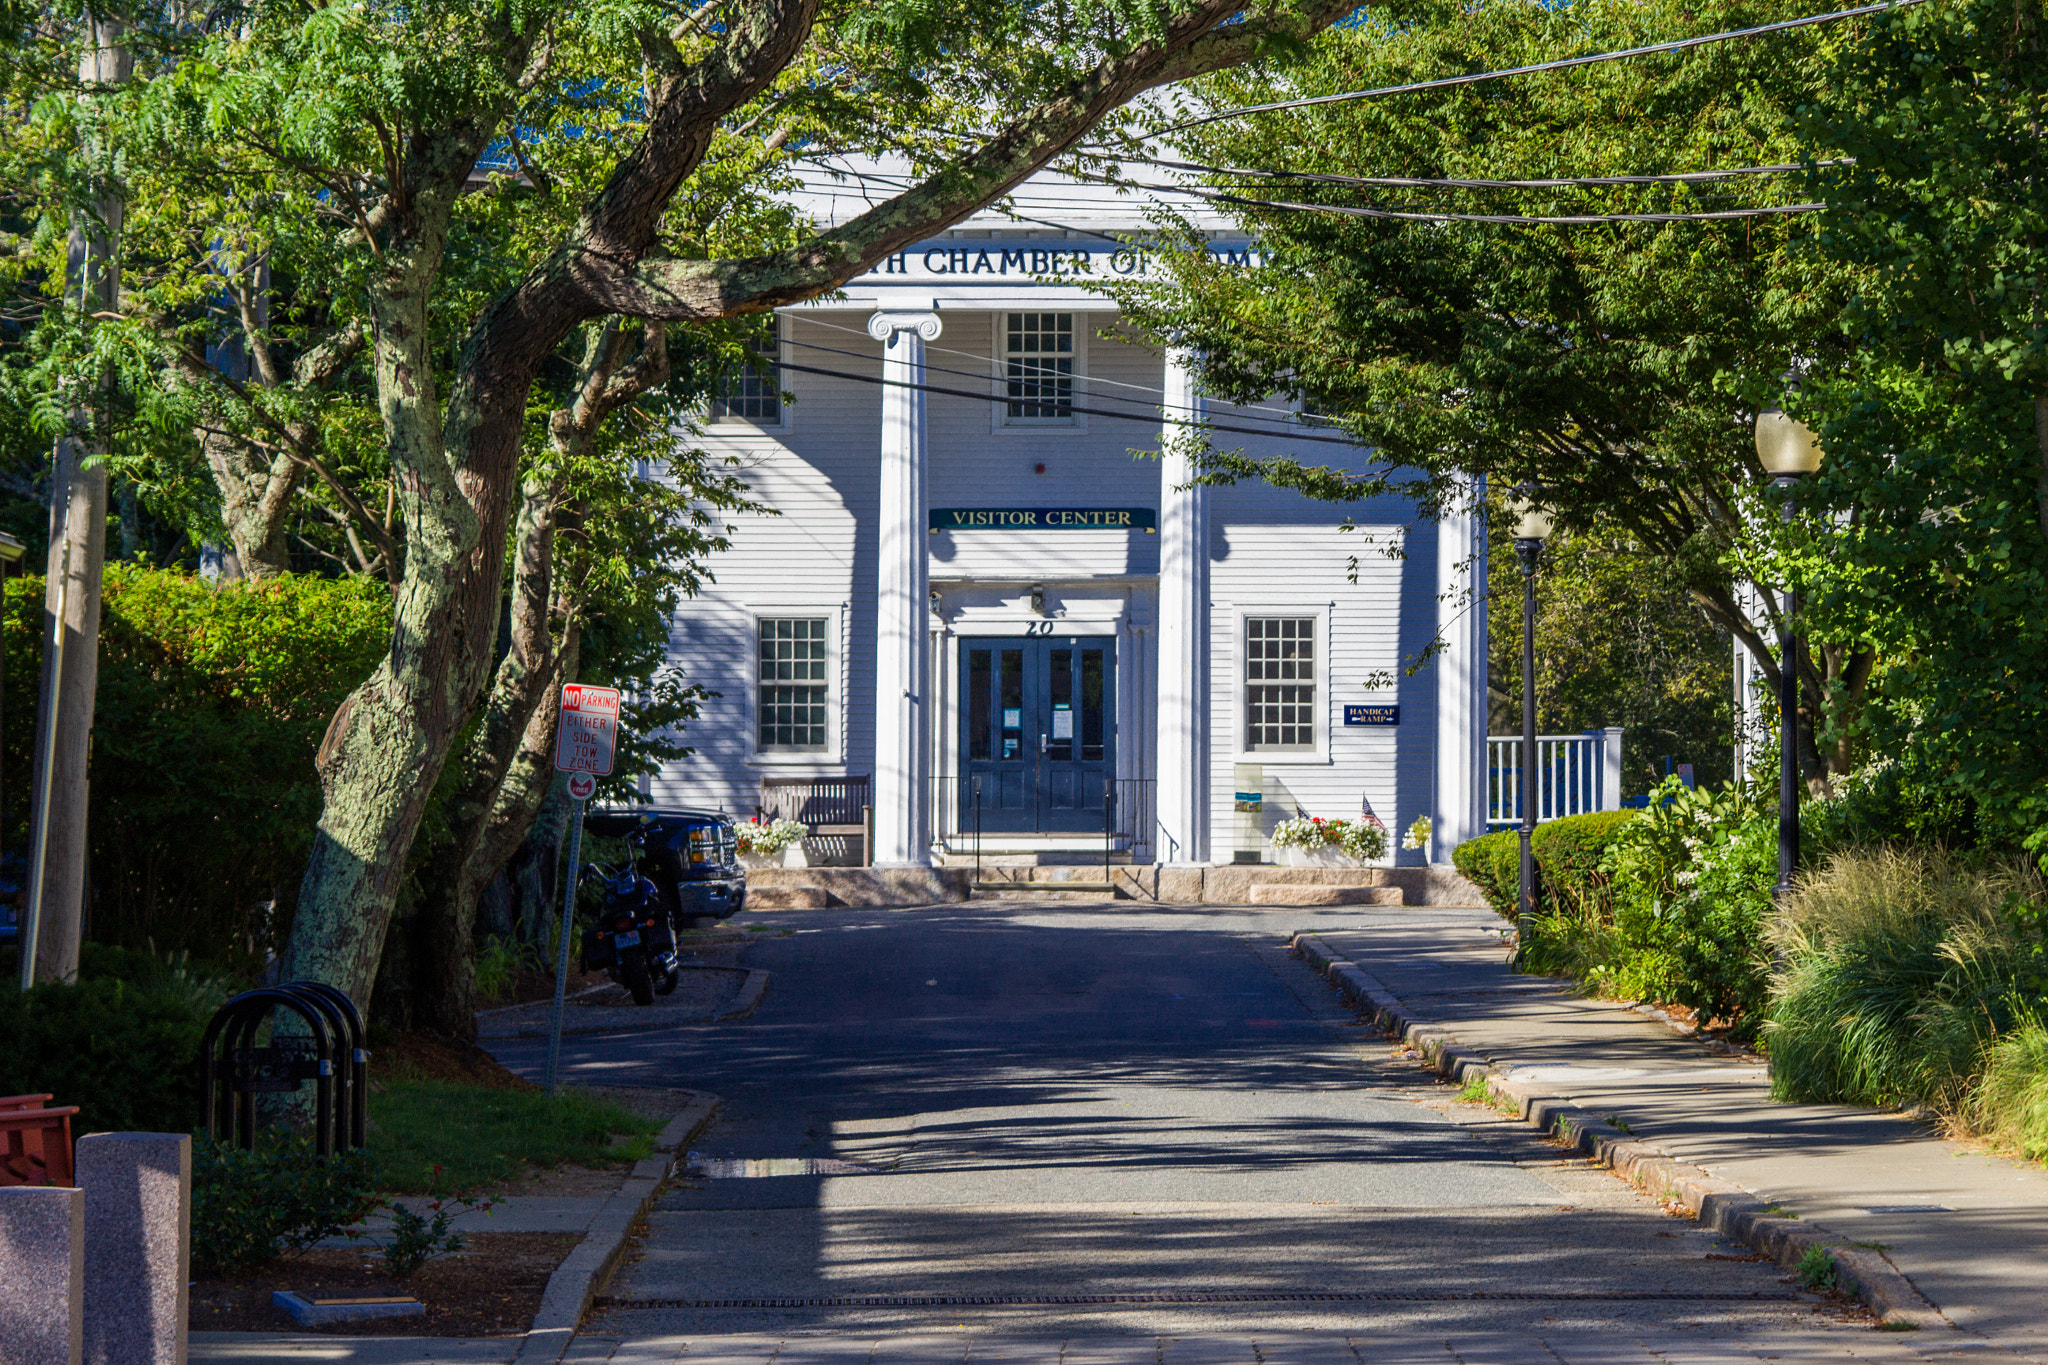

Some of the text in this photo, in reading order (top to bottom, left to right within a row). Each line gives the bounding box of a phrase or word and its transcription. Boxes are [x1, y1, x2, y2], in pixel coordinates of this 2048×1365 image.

[923, 248, 1094, 275] CHAMBER
[1110, 249, 1151, 275] OF
[952, 511, 1132, 526] VISITOR CENTER
[1025, 620, 1054, 636] 20
[563, 689, 616, 709] NO PARKING
[1349, 708, 1395, 716] HANDICAP
[1360, 715, 1386, 723] RAMP
[566, 715, 607, 730] EITHER
[572, 731, 598, 745] SIDE
[575, 745, 598, 758] TOW
[569, 757, 599, 771] ZONE
